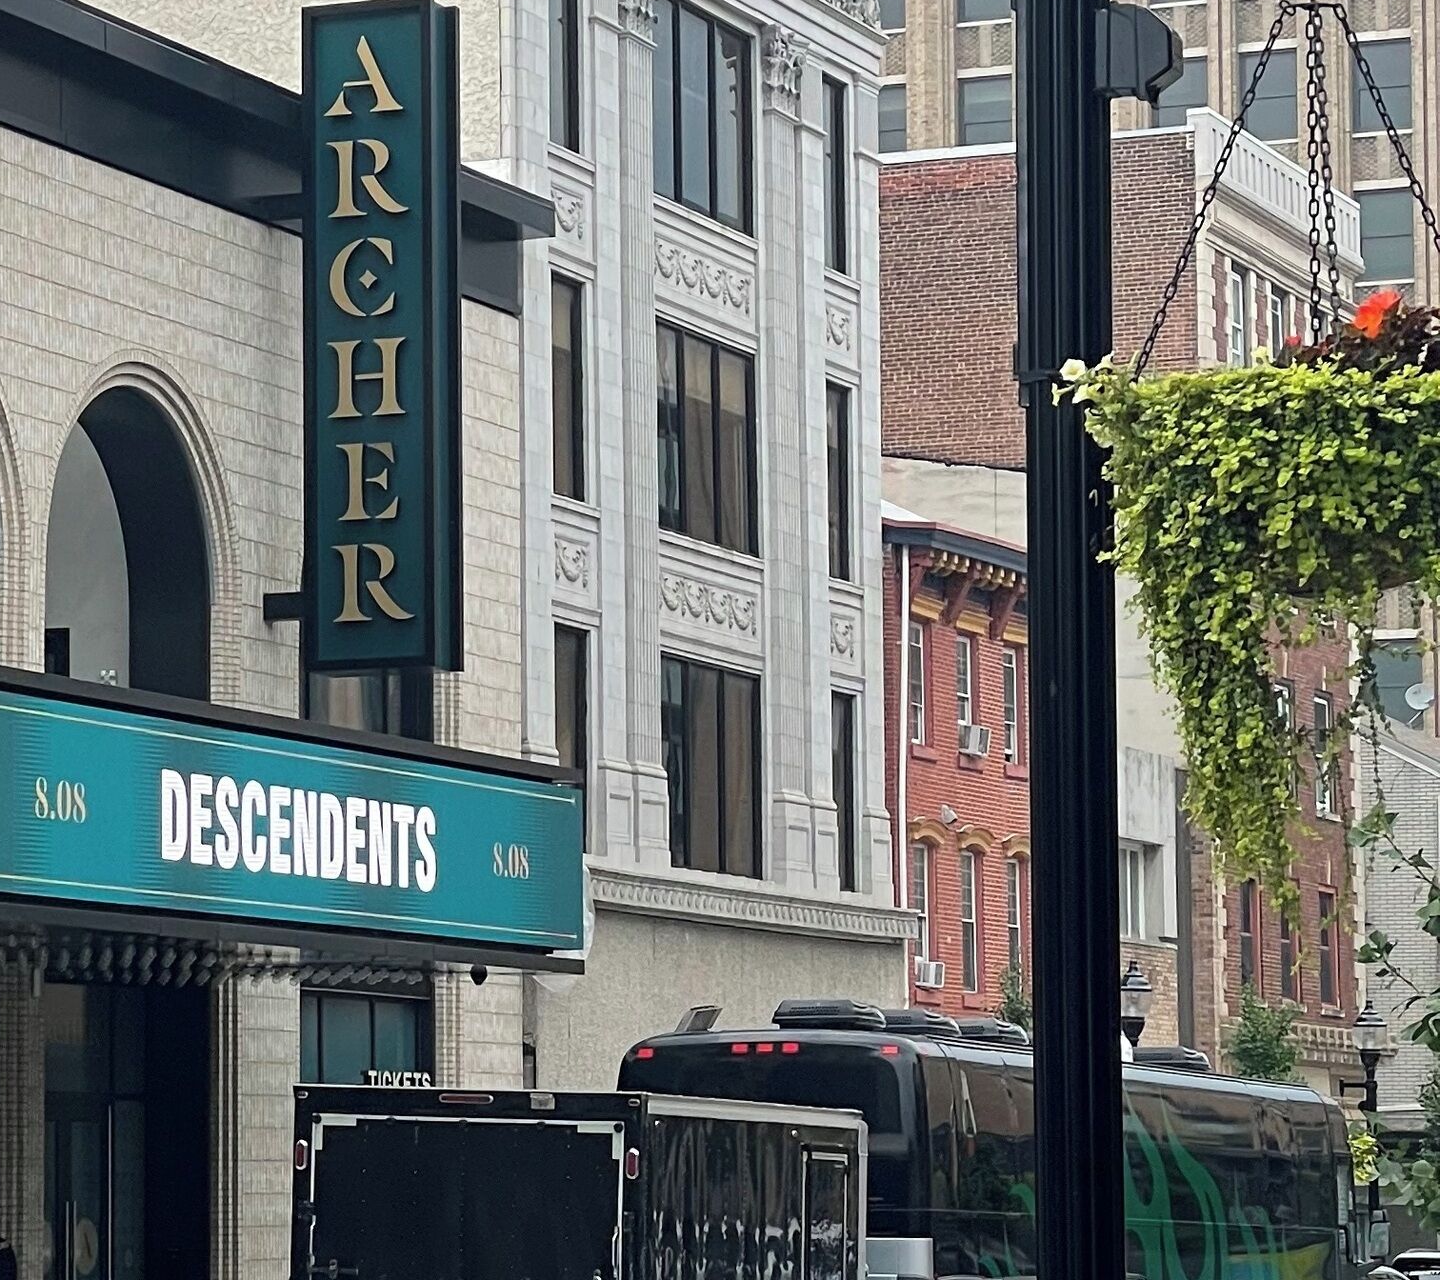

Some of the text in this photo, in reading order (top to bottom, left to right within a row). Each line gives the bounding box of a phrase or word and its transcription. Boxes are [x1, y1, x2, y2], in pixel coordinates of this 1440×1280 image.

[324, 35, 416, 624] ARCHER
[34, 775, 87, 824] 8.08
[160, 768, 438, 893] DESCENDENTS
[492, 841, 530, 880] 8.08
[368, 1070, 431, 1088] TICKETS
